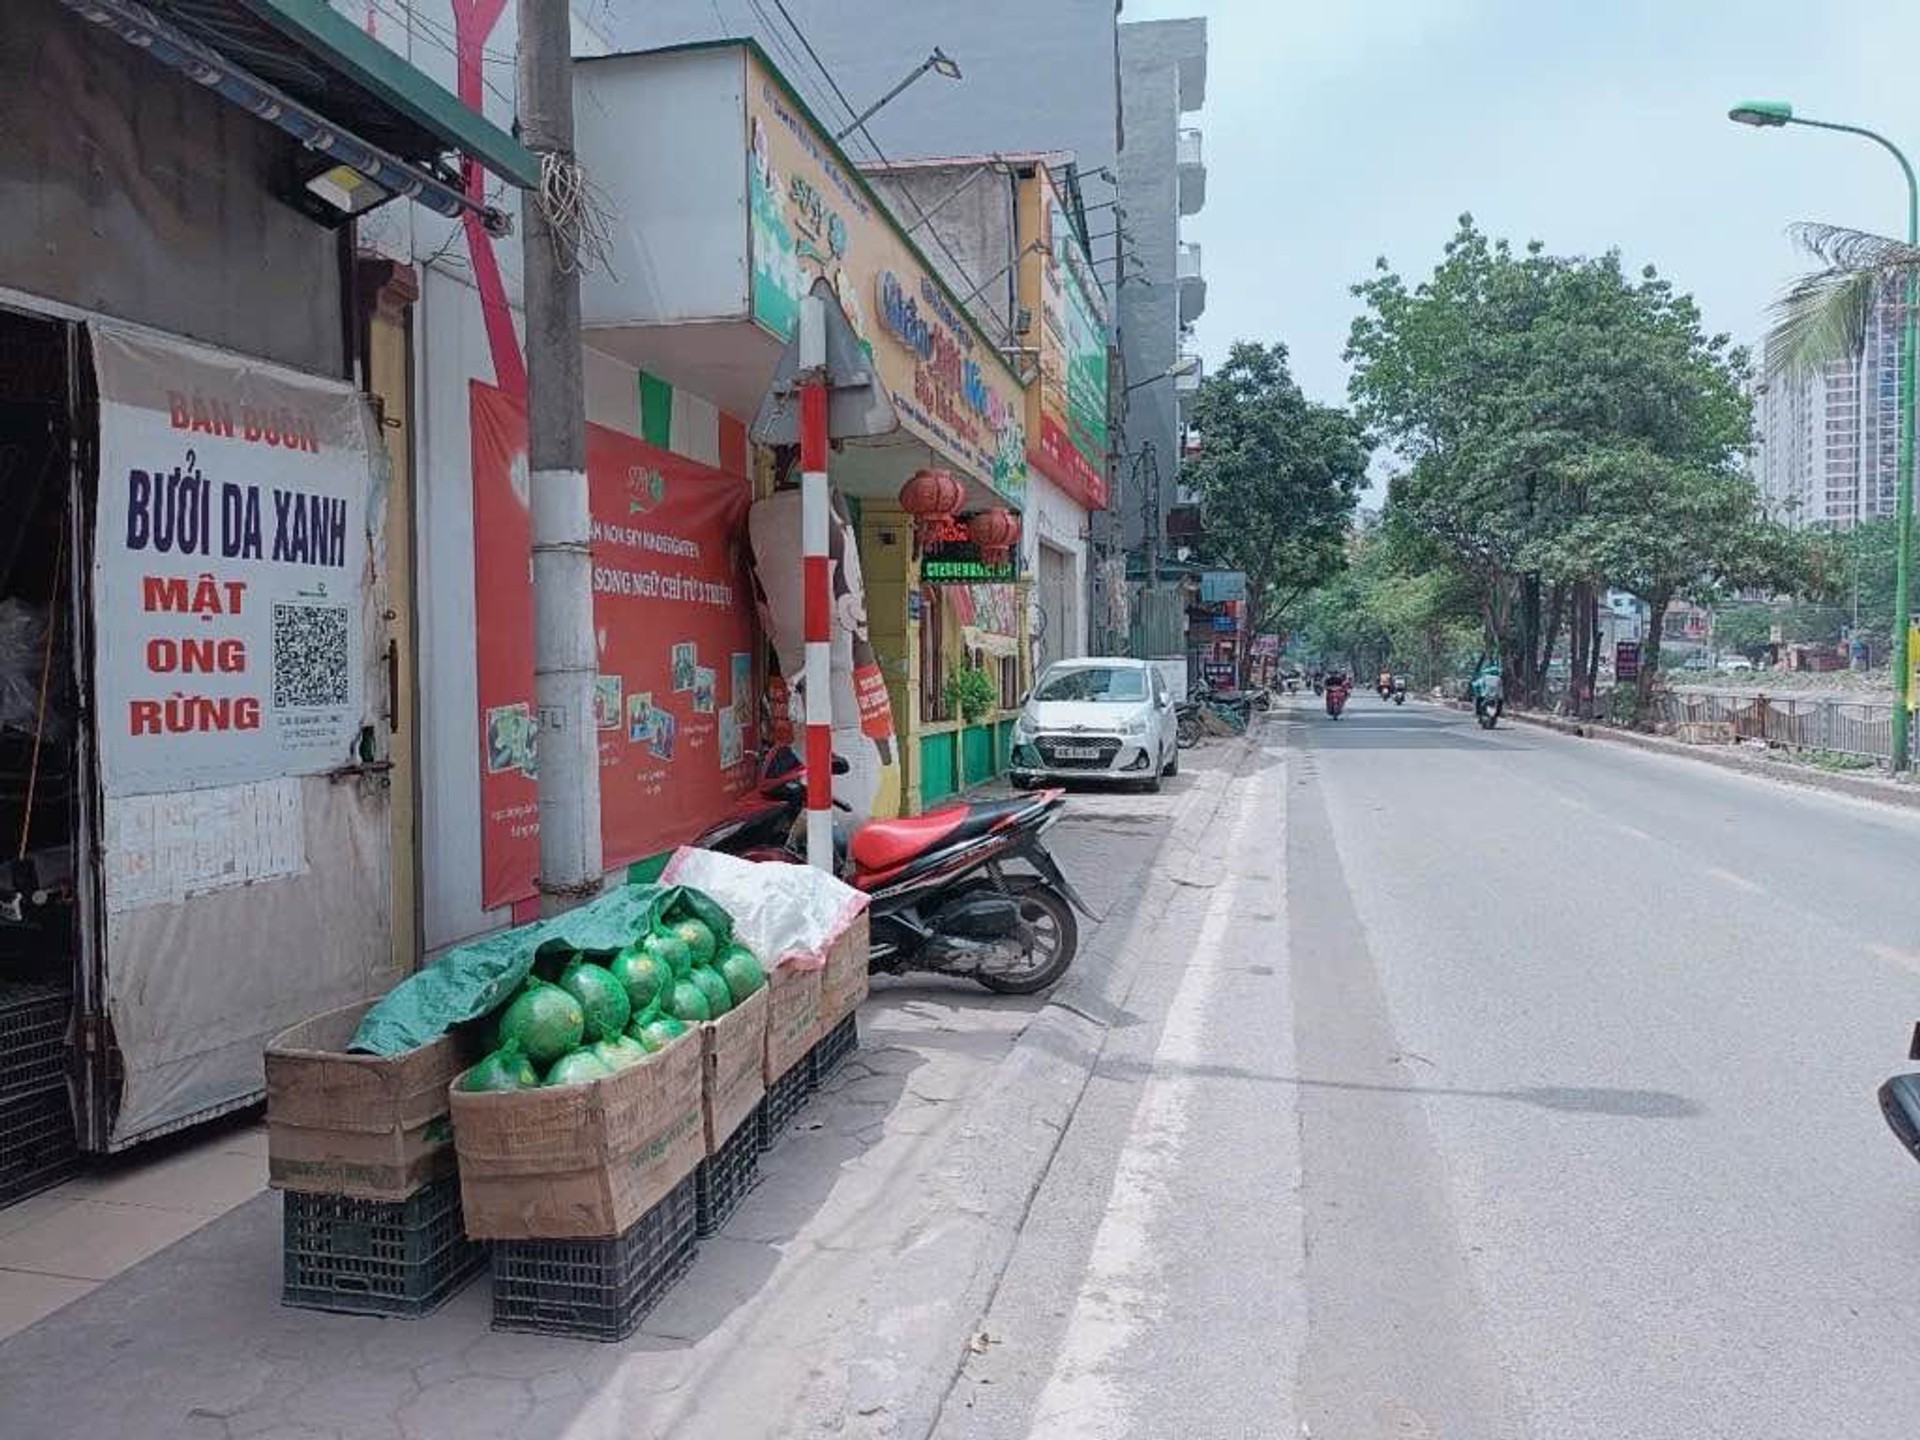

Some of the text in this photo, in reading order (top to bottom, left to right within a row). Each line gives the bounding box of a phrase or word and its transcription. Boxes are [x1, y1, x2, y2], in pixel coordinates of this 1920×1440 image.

[126, 449, 347, 567] BƯỞI DA XANH
[143, 573, 247, 621] MẬT
[594, 567, 631, 595] SONG
[146, 638, 246, 674] ONG
[129, 691, 260, 736] RỪNG
